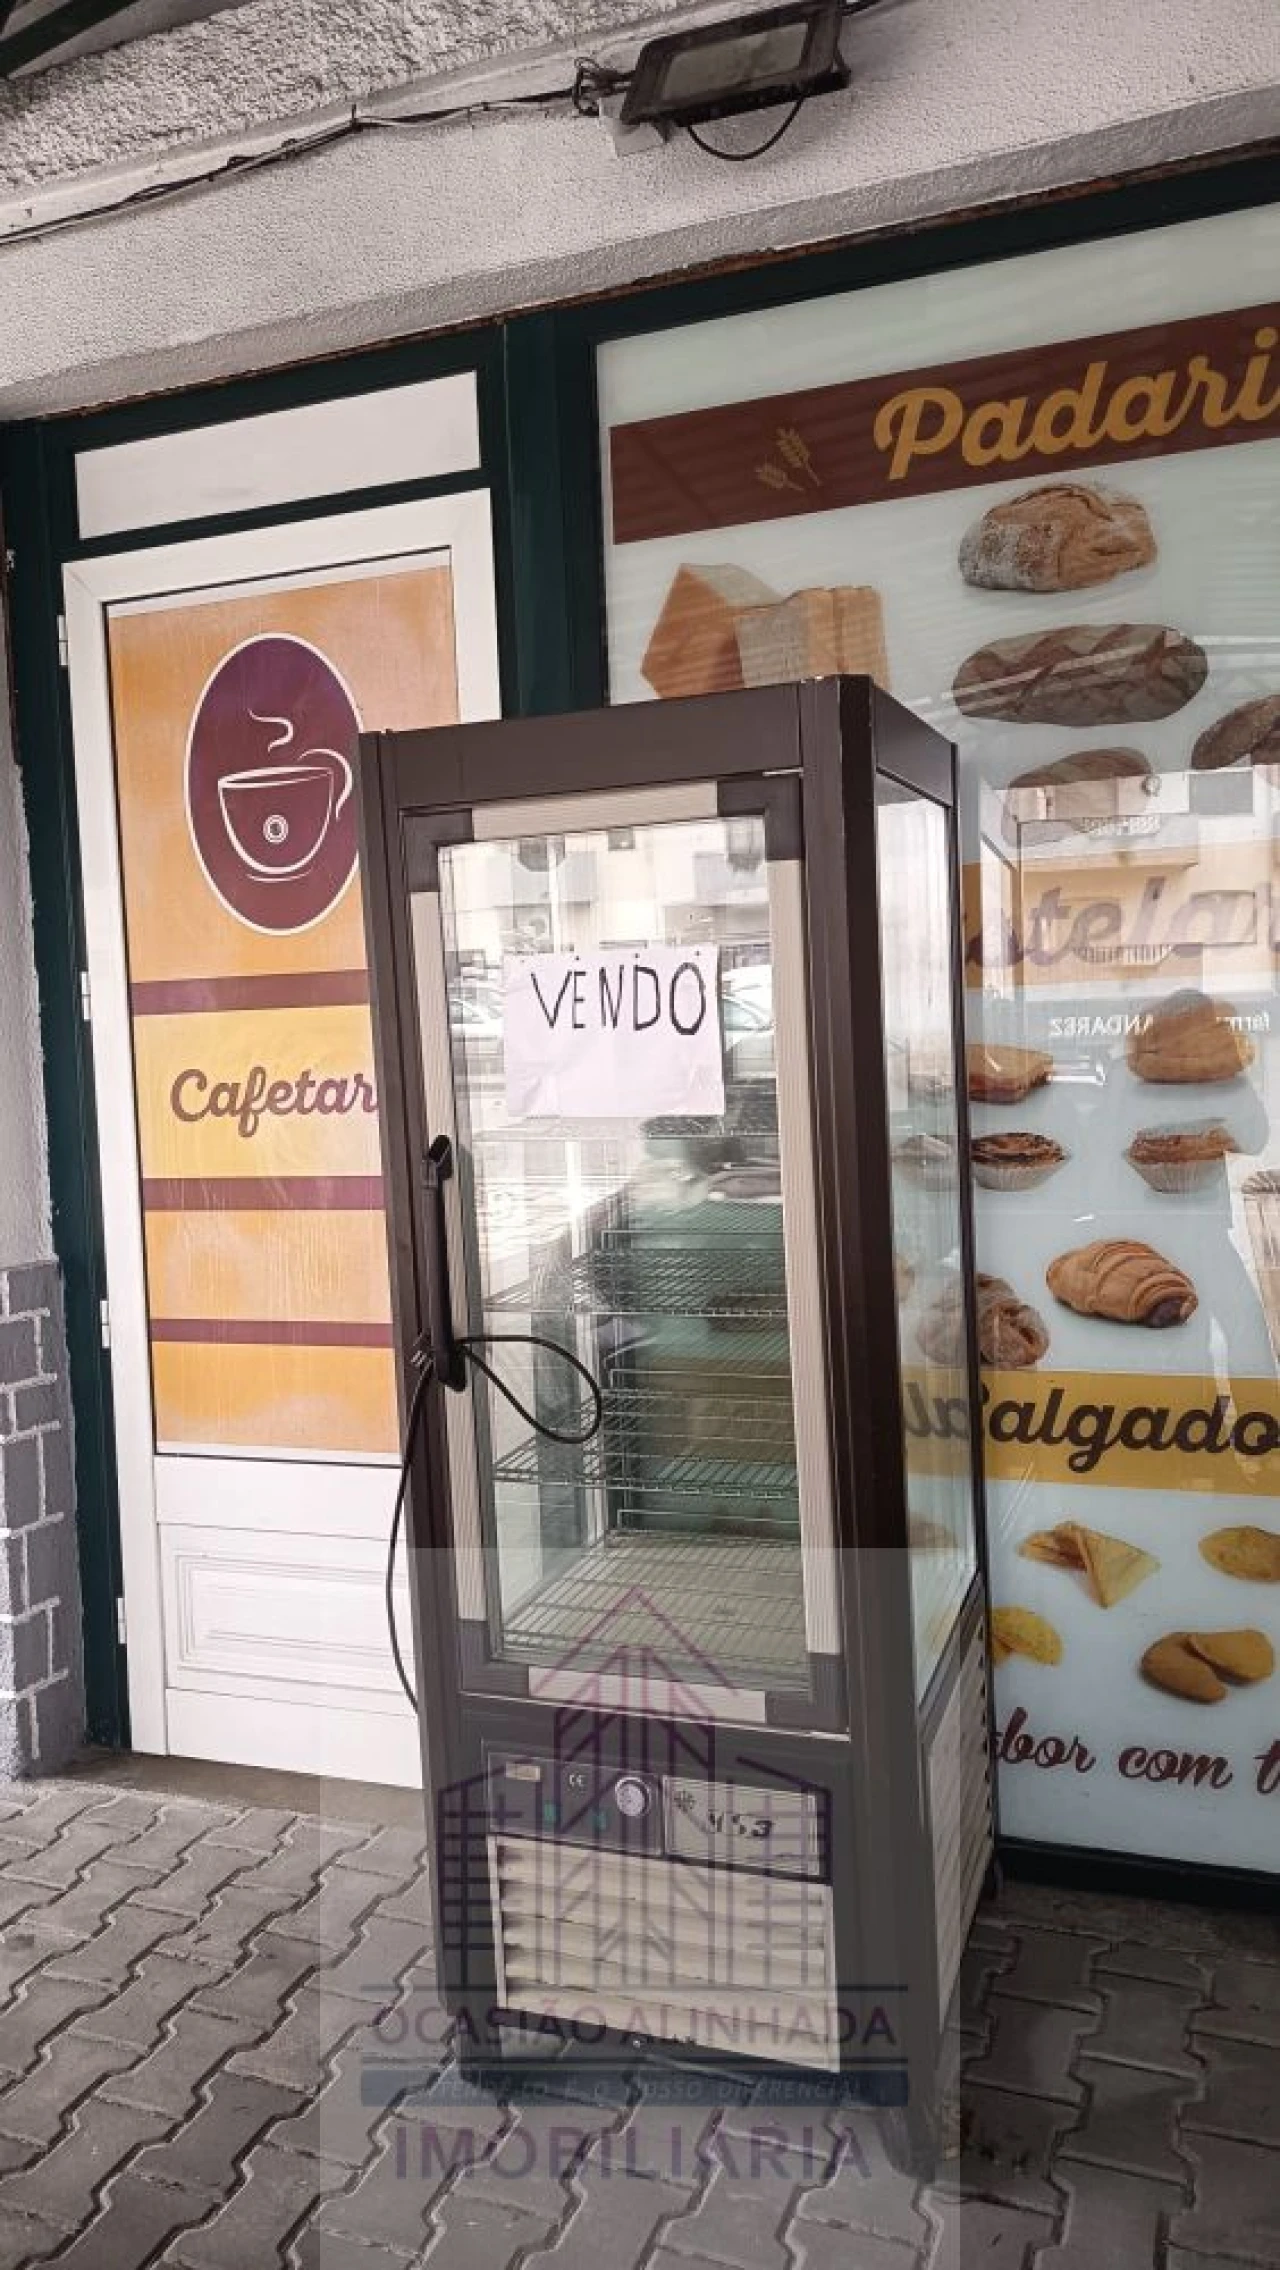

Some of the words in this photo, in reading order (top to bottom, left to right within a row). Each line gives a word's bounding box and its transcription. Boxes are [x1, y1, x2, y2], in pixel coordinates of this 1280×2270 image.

[530, 960, 706, 1035] VENDO
[170, 1066, 379, 1138] Cafetar
[980, 1384, 1280, 1473] algado
[1118, 1746, 1233, 1789] com
